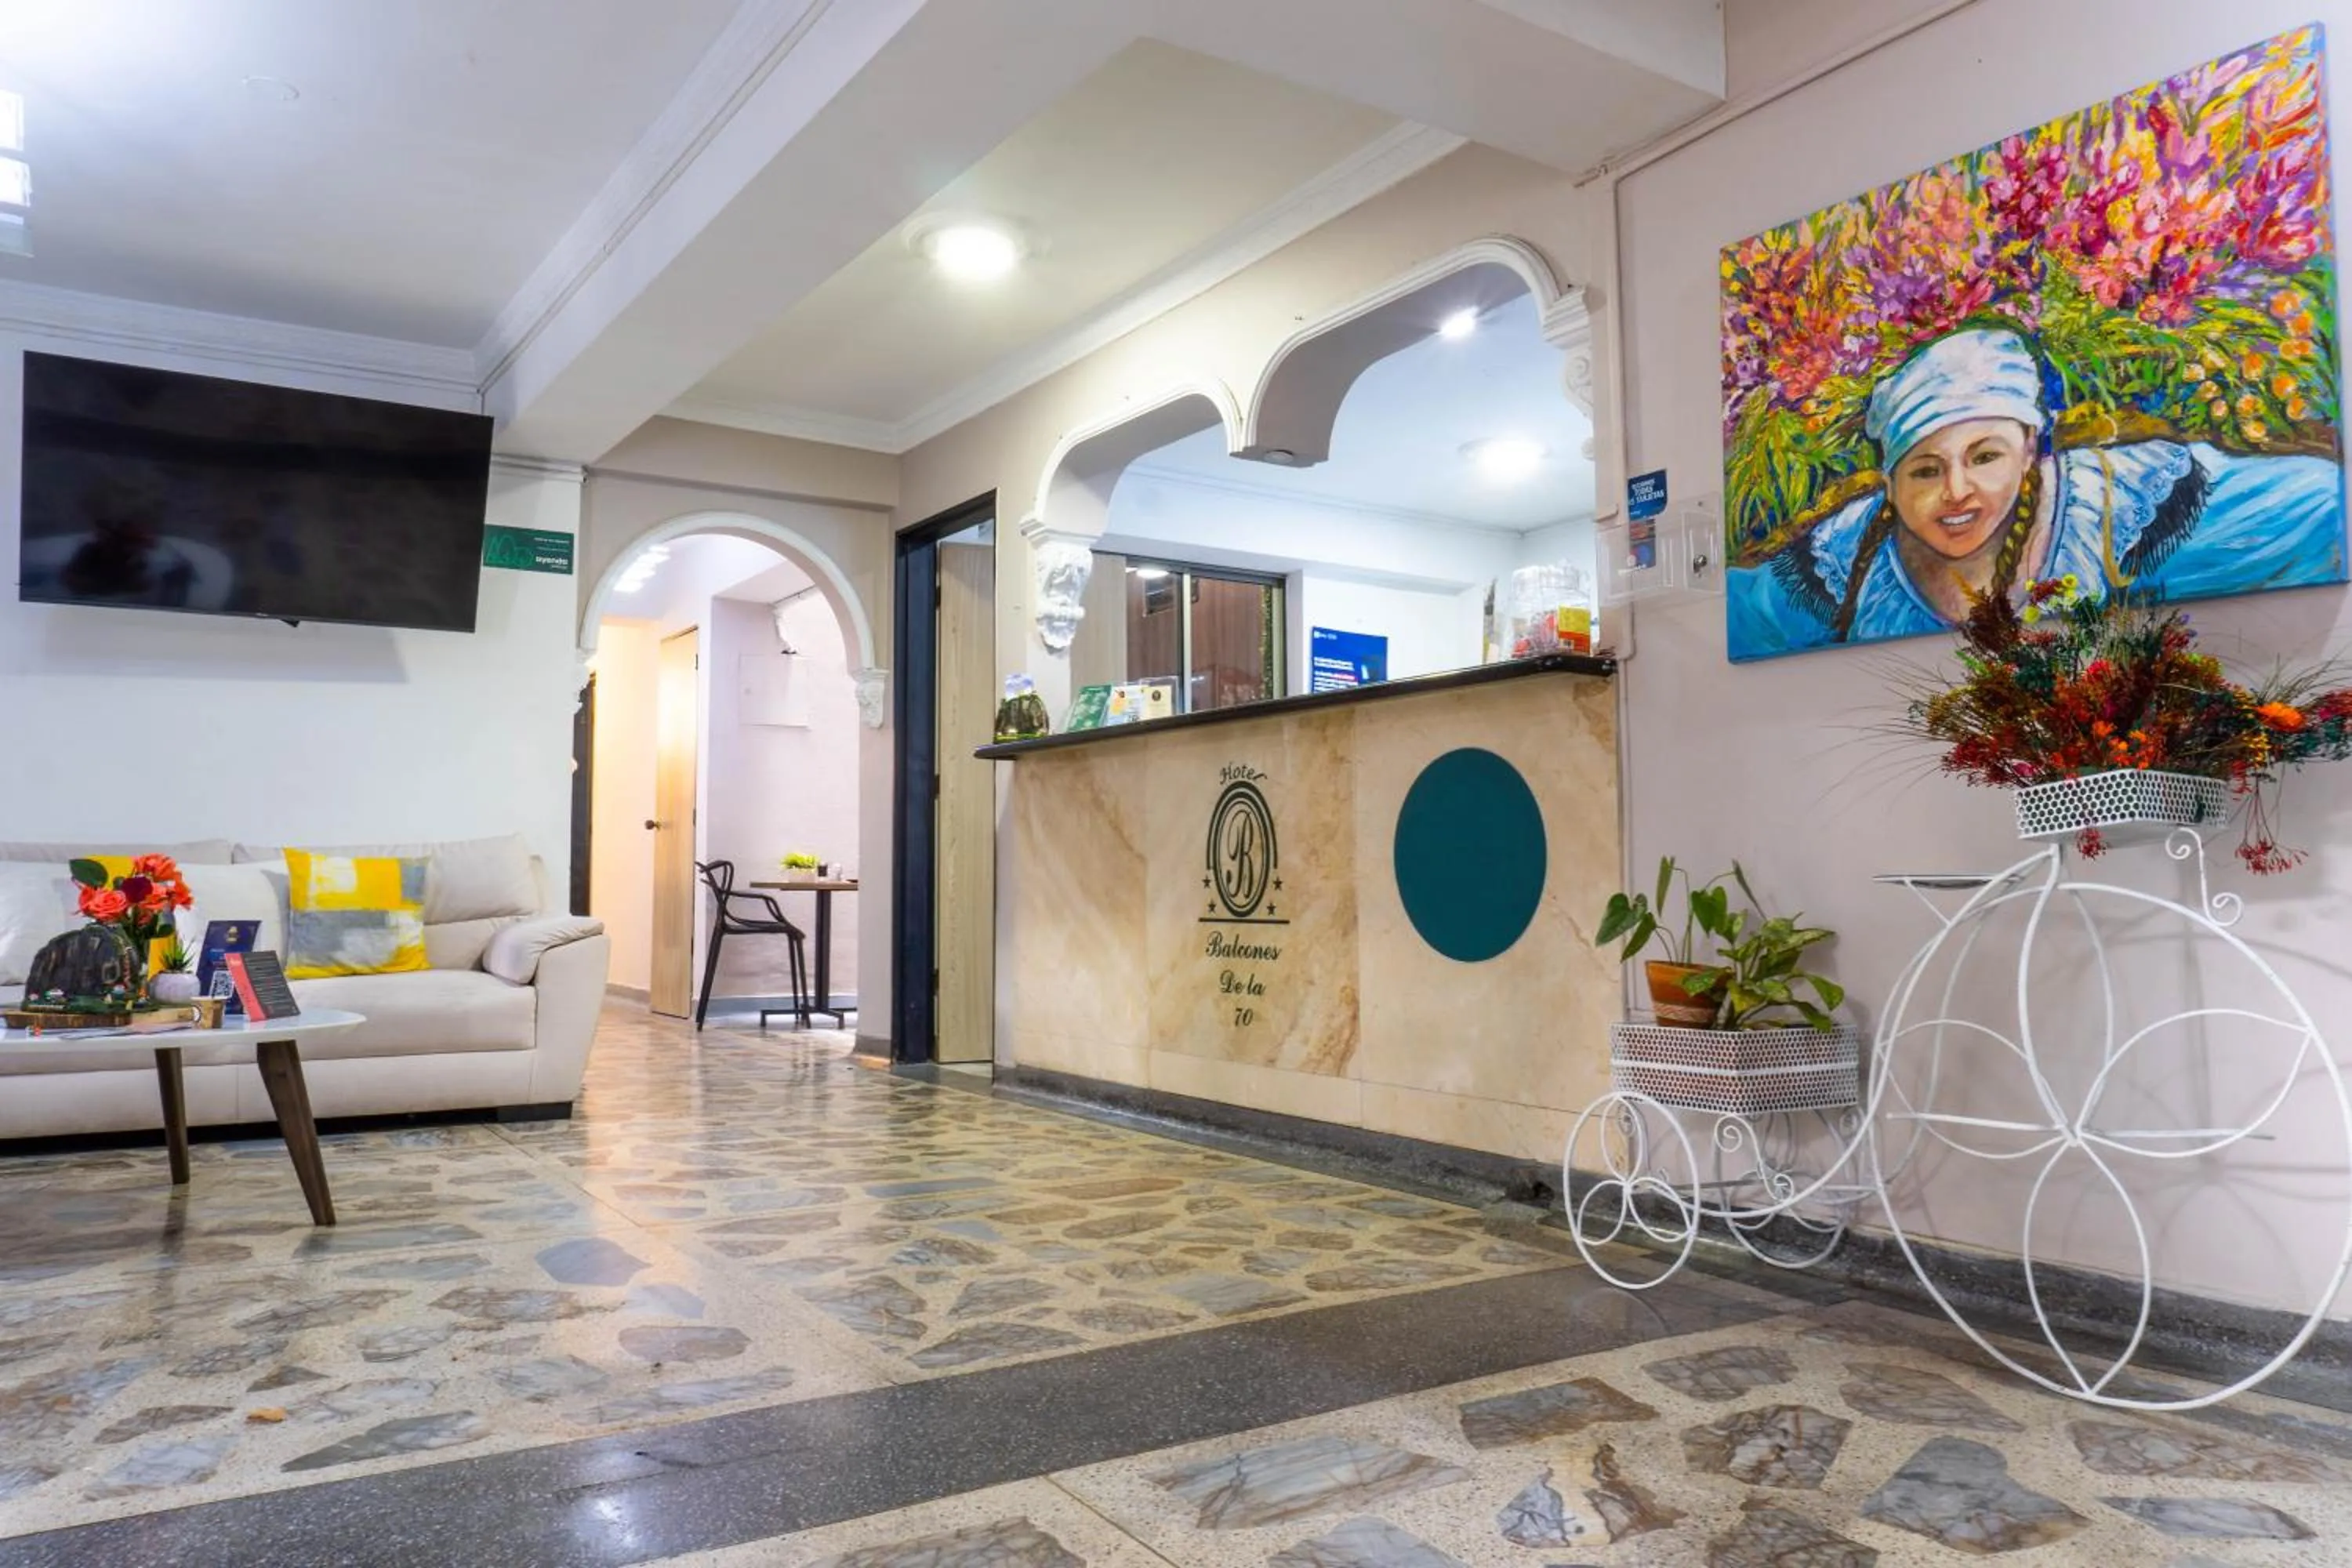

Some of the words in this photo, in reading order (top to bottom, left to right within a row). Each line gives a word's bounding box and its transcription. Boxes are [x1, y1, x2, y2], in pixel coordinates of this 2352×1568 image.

[1219, 760, 1268, 785] Hotel
[1205, 930, 1282, 961] Balcones
[1219, 969, 1246, 995] De
[1247, 975, 1266, 996] la
[1234, 1007, 1254, 1027] 70
